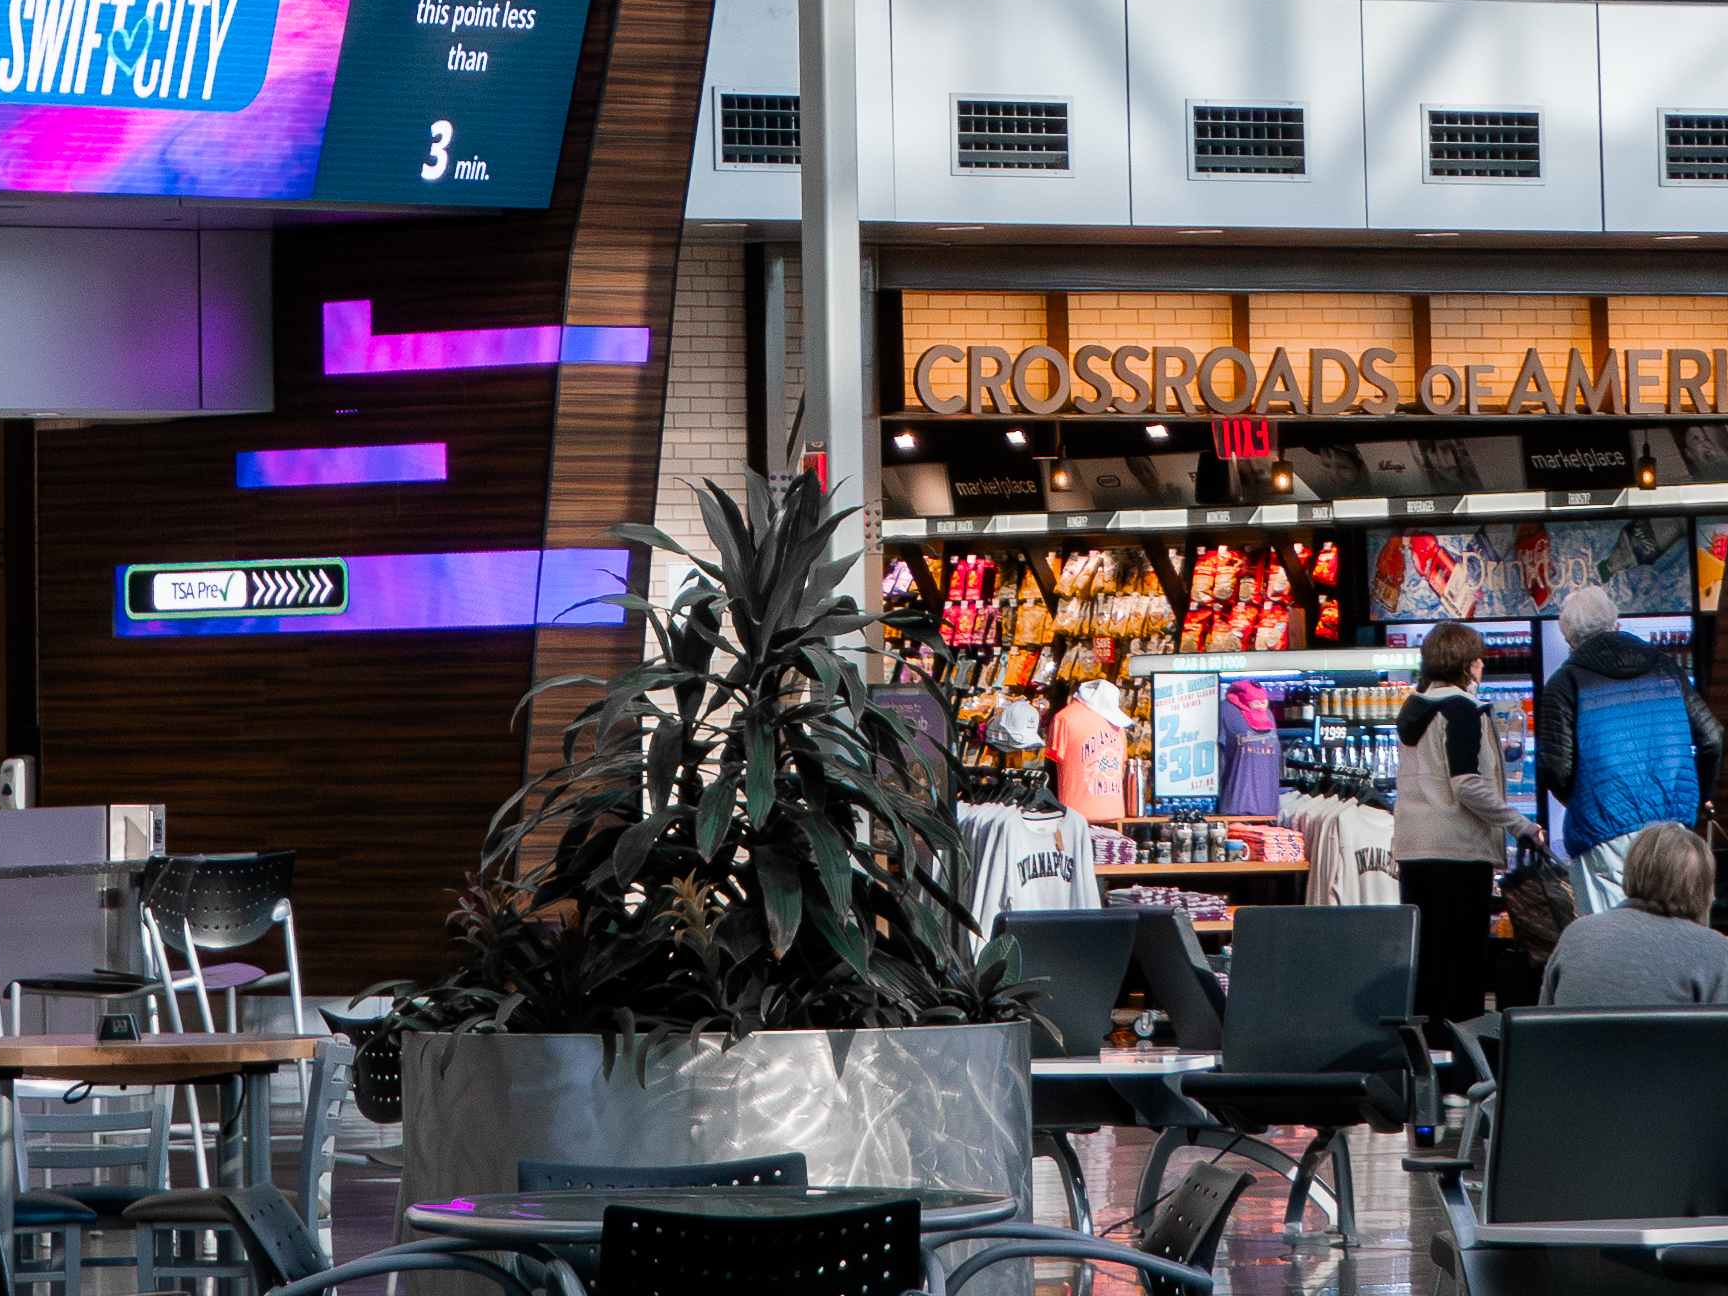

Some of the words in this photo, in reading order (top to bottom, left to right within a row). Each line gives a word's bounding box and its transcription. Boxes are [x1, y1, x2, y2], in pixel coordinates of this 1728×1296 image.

[450, 0, 496, 32] point
[501, 2, 537, 31] less
[447, 43, 489, 72] than
[421, 119, 454, 180] 3
[454, 154, 490, 181] min.
[914, 344, 1399, 416] CROSSROADS
[1420, 362, 1496, 416] OF
[1530, 446, 1627, 474] marketplace
[954, 476, 1038, 500] marketplace
[171, 581, 195, 600] TSA
[1173, 657, 1198, 671] GRAB
[1222, 656, 1248, 670] FOOD
[1158, 713, 1181, 749] 2
[1179, 729, 1200, 744] for
[1157, 739, 1215, 783] $30
